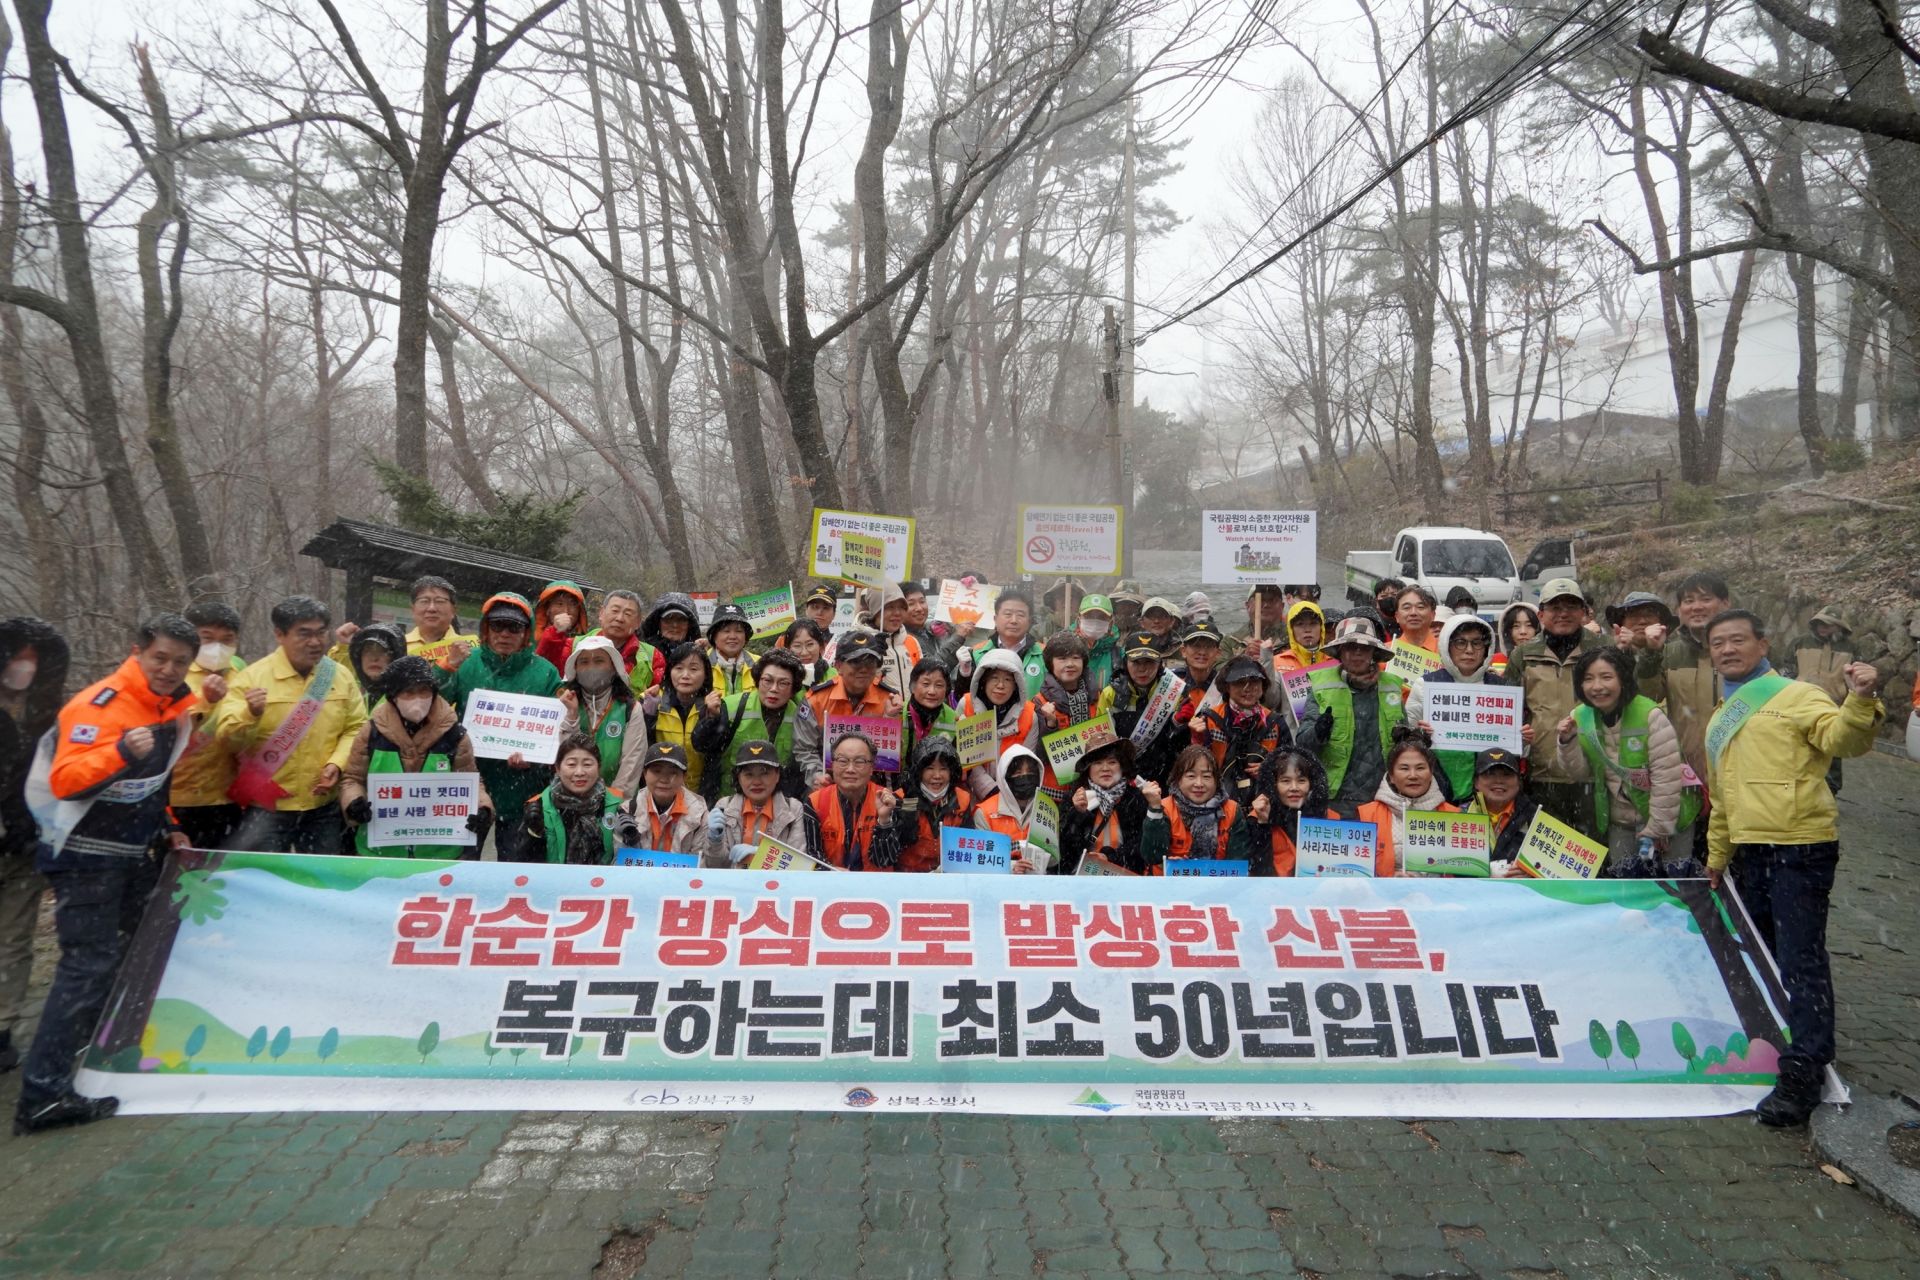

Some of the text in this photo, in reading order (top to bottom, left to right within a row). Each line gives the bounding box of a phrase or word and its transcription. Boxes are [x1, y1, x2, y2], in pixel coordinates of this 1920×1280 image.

[821, 517, 907, 535] 담배연기 없는 더 좋은 국립공원
[1210, 514, 1310, 523] 국립공원의 소중한 자연자원을
[1218, 525, 1257, 533] 산불로부터
[845, 542, 863, 553] 함께지킨
[845, 554, 863, 566] 함께웃는
[745, 609, 766, 620] 못쓰면
[1396, 647, 1422, 664] 함께지킨
[1393, 657, 1419, 674] 함께웃는
[1288, 676, 1309, 688] 잘못다
[1432, 694, 1514, 709] 산불나면 자연파괴
[476, 700, 559, 720] 태울때는 설마설마
[472, 713, 554, 736] 처벌받고 후회막심
[1432, 711, 1513, 726] 산불내면 인생파괴
[866, 725, 897, 736] 작은불씨
[959, 725, 973, 739] 함께지킨
[1048, 733, 1079, 752] 설마속에
[1081, 721, 1110, 740] 숨은불씨
[1445, 732, 1499, 742] 성북구안전보안관
[1052, 745, 1083, 764] 방심속에
[377, 786, 469, 799] 산불 나면 잿더미
[378, 804, 468, 818] 불낸 사람 빚더미
[394, 828, 453, 836] 성북구안전보안관
[1303, 825, 1371, 842] 가꾸는데 30년
[1409, 820, 1486, 835] 설마속에 숨은불씨
[958, 837, 994, 852] 불조심을
[1302, 840, 1370, 858] 사라지는데 3초
[1408, 834, 1485, 851] 방심속에 큰불된다
[1536, 822, 1598, 865] 함께지킨 화재예방
[948, 850, 1004, 867] 생활화 합시다
[1530, 835, 1591, 879] 함께웃는 밝은내일
[392, 896, 1446, 972] 한순간 방심으로 발생한 산불,
[495, 979, 1560, 1060] 복구하는데 최소 50년입니다
[687, 1094, 756, 1105] 성북구청
[886, 1096, 976, 1107] 성북소방서
[1135, 1089, 1186, 1100] 국립공원공단
[1136, 1101, 1316, 1112] 북한산국립공원사무소
